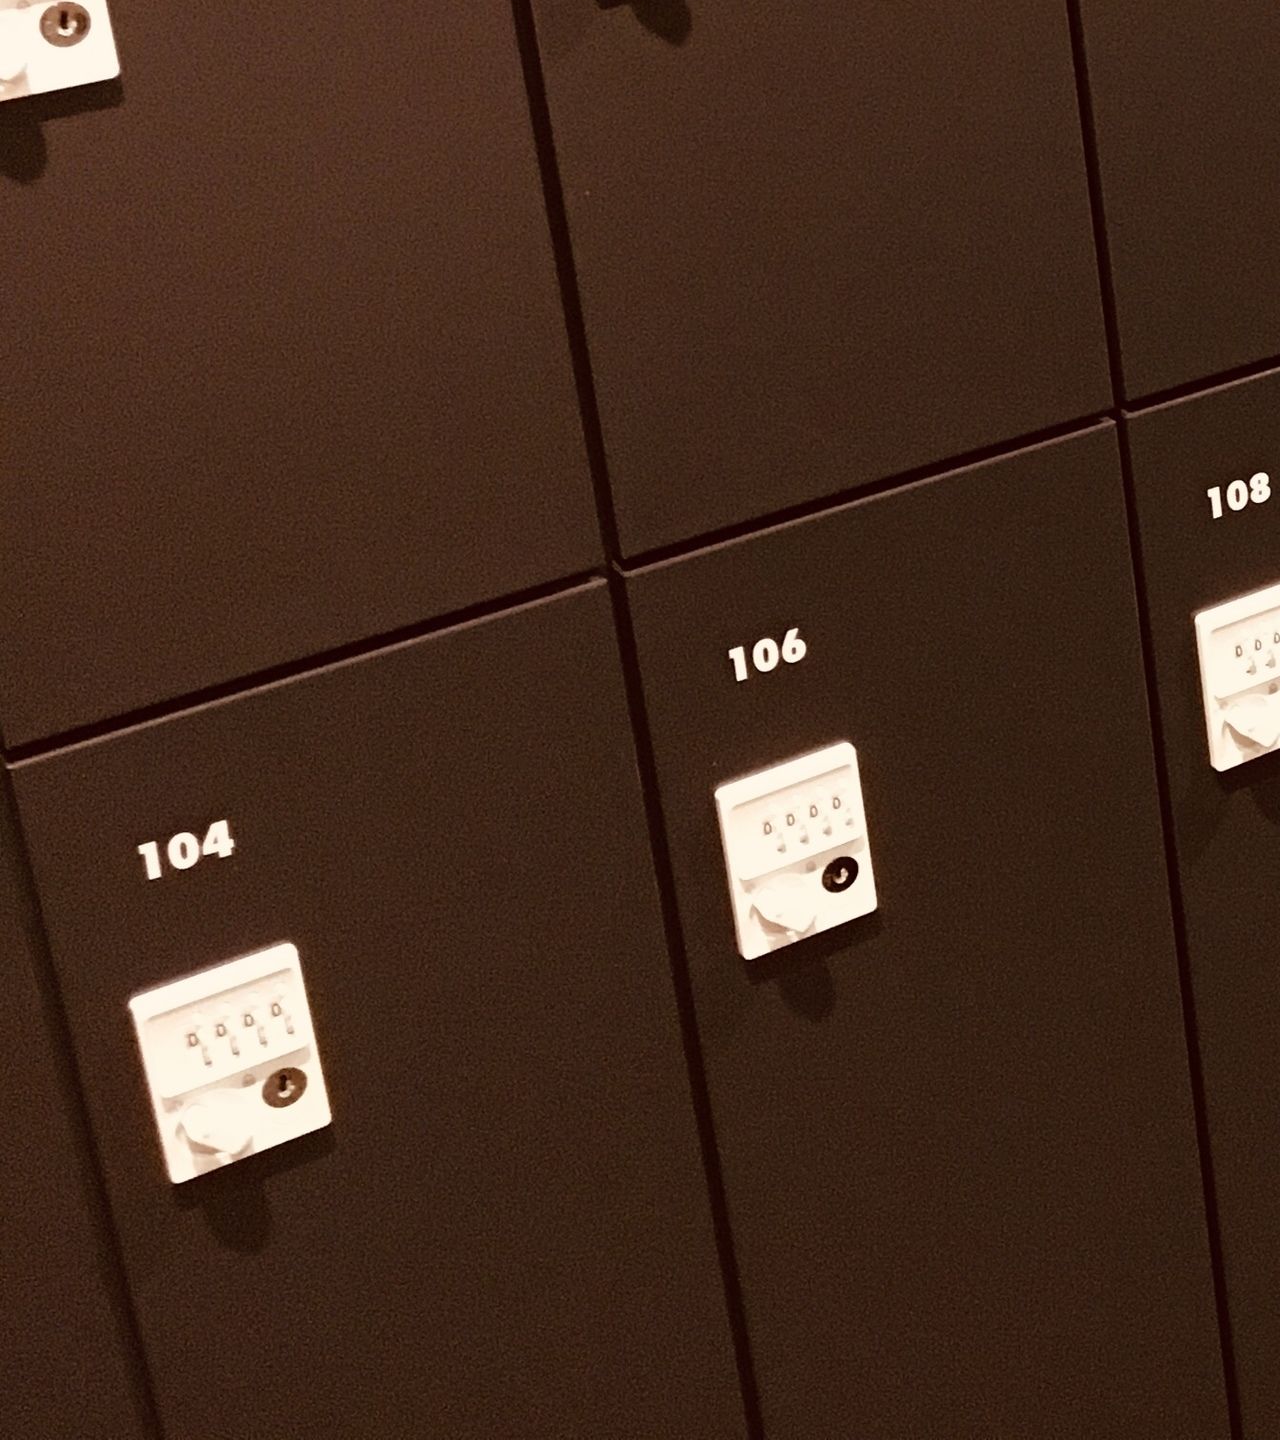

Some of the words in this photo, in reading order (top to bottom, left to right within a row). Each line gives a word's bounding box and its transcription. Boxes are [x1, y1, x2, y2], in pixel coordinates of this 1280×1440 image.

[1208, 473, 1270, 518] 108
[729, 628, 806, 681] 106
[138, 820, 234, 880] 104
